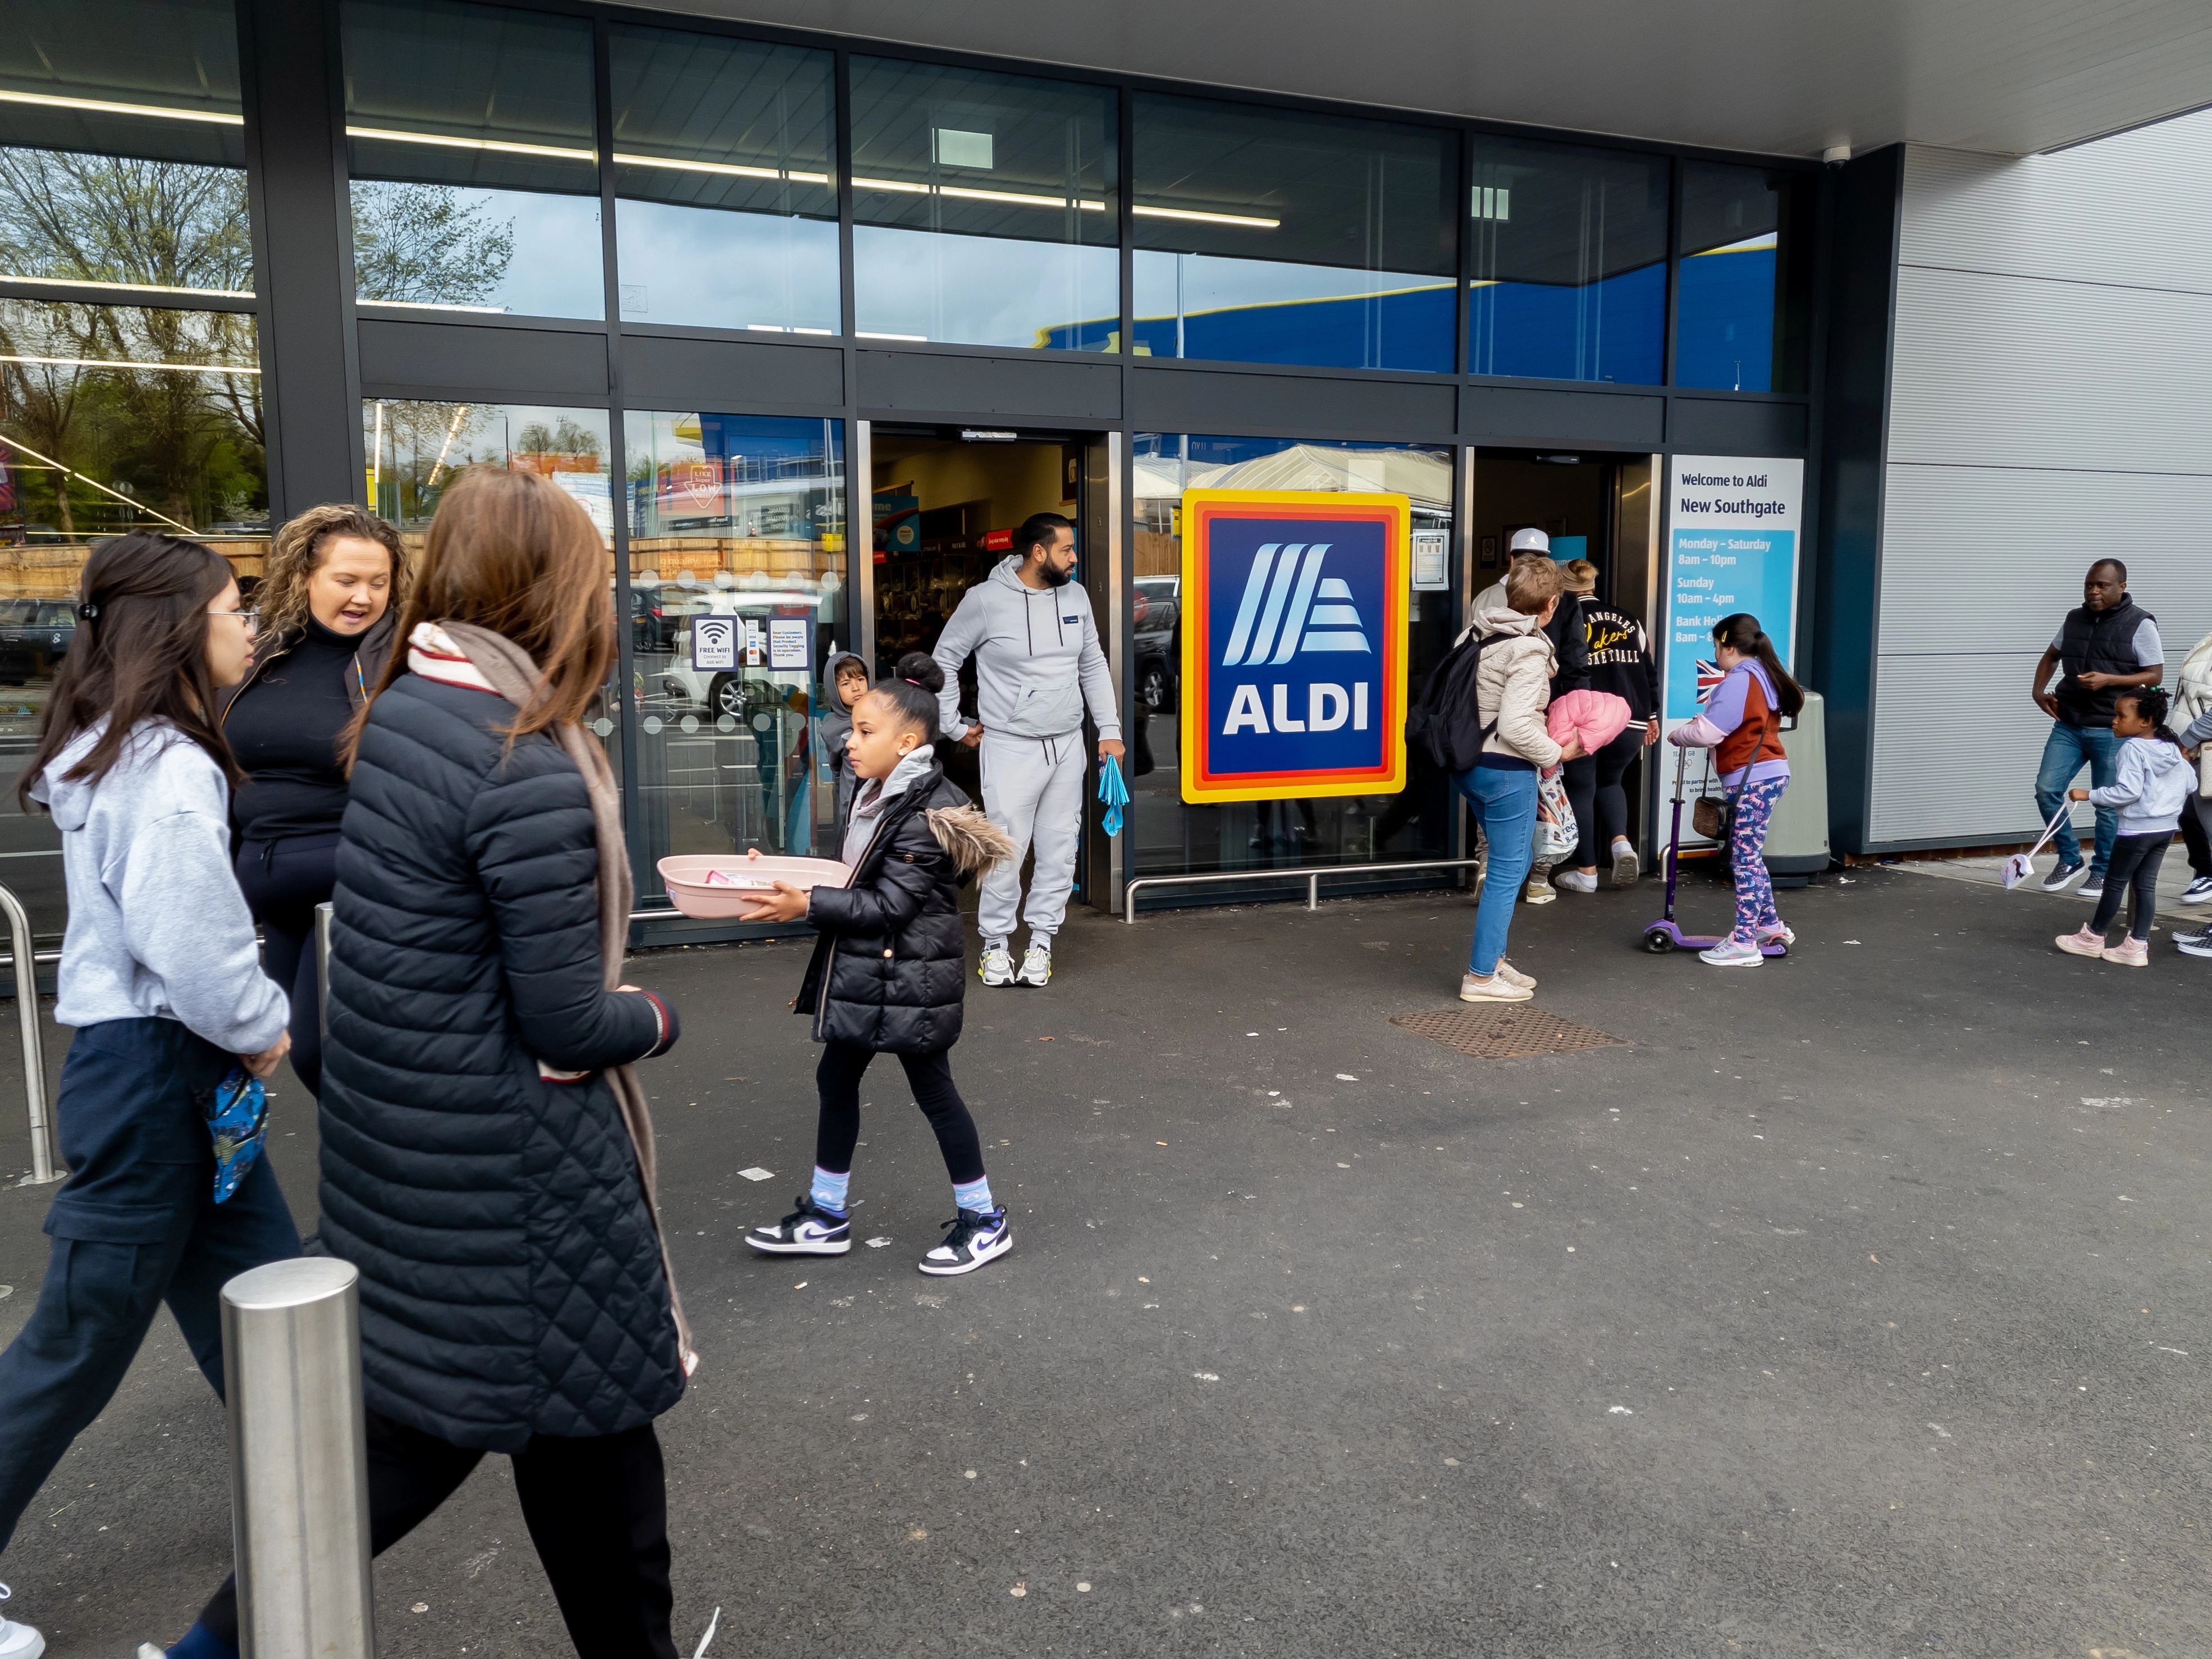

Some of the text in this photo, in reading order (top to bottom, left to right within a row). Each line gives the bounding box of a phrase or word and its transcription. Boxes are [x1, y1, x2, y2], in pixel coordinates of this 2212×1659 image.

[1681, 473, 1767, 487] Welcome to Aldi
[692, 483, 716, 492] LOW
[1681, 499, 1785, 518] New Southgate
[1679, 538, 1718, 551] Monday
[1727, 538, 1771, 552] Saturday
[1679, 554, 1700, 565] 8am
[1710, 554, 1736, 568] 10pm
[1677, 577, 1714, 590] Sunday
[1677, 593, 1702, 604] 10am
[1713, 593, 1734, 606] 4pm
[1588, 611, 1635, 633] ANGELES
[1676, 615, 1701, 627] Bank
[1675, 632, 1697, 642] 8am
[1222, 682, 1368, 734] ALDI
